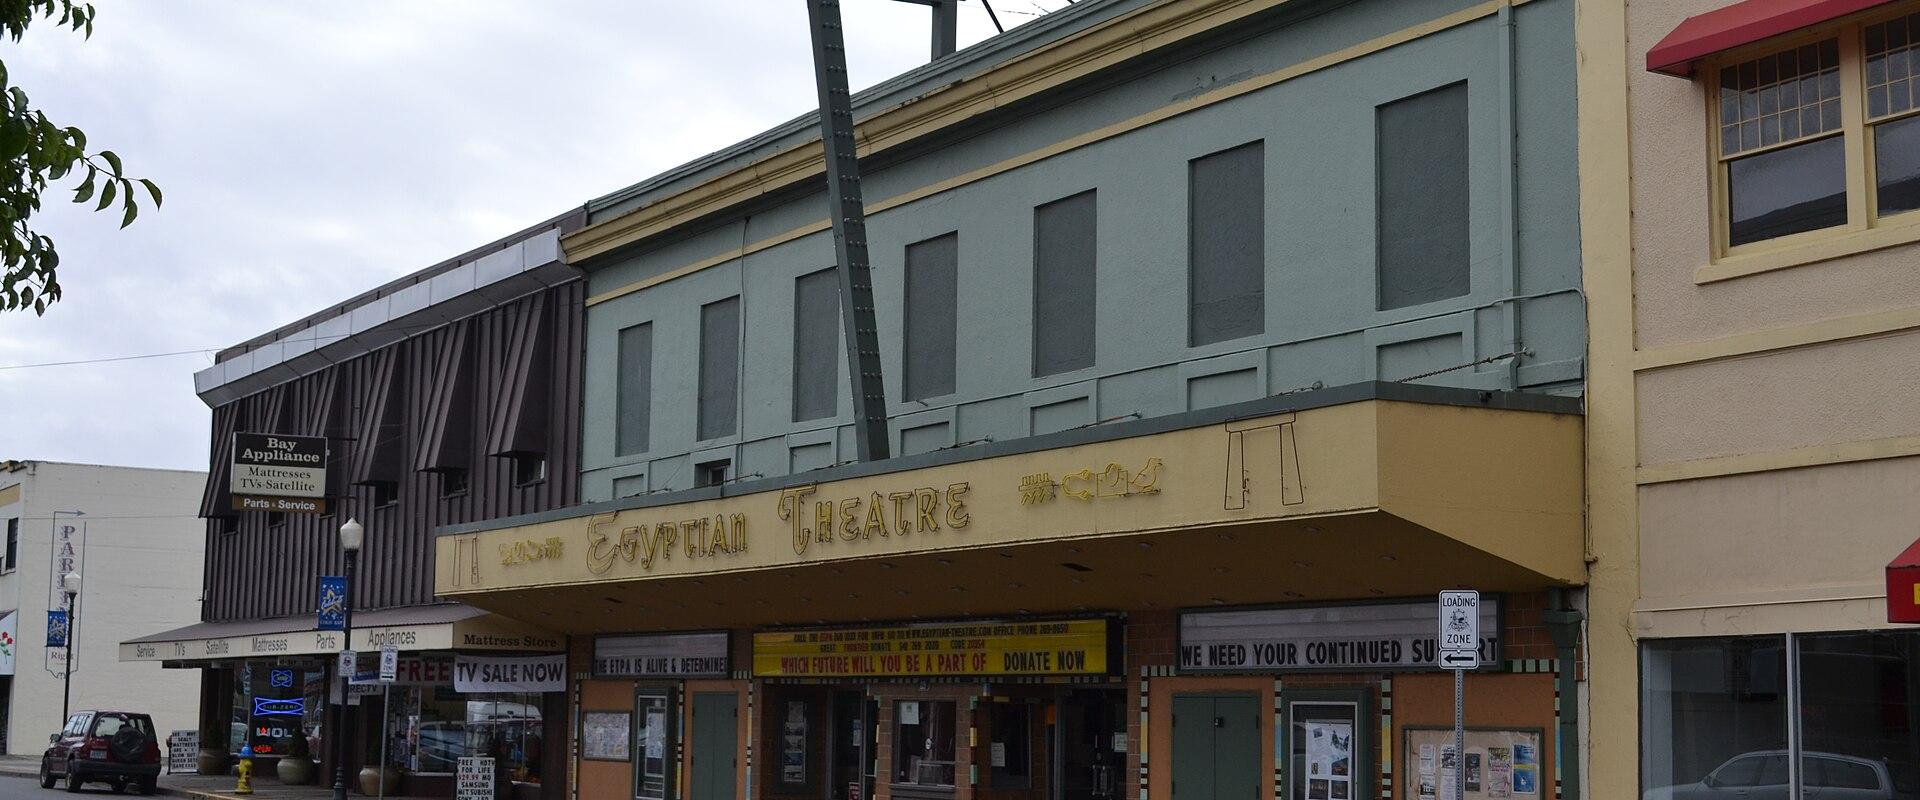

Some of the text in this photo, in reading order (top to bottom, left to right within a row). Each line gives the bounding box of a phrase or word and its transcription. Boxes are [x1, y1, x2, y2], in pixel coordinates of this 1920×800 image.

[266, 437, 297, 452] Bay
[241, 448, 320, 463] Appliance
[248, 466, 312, 480] Mattresses
[243, 498, 270, 508] Parts
[278, 500, 316, 510] Service
[776, 480, 971, 556] THEATRE
[1442, 597, 1476, 608] LOADING
[136, 645, 156, 659] Service
[205, 640, 230, 655] Satellite
[252, 637, 288, 653] Mattresses
[316, 633, 336, 650] Parts
[367, 629, 417, 650] Appliances
[463, 634, 558, 648] Mattress Store
[1446, 634, 1471, 644] ZONE
[51, 651, 74, 663] Rigt
[1181, 637, 1498, 667] WE NEED YOUR CONTINUED SURT
[594, 658, 607, 674] THE
[634, 658, 642, 673] IS
[646, 657, 668, 673] ALIVE
[671, 658, 677, 673] &
[781, 650, 1085, 674] WHICH FUTURE WILL YOU BE A PART OF DONATE NOW
[396, 659, 450, 682] FREE
[457, 662, 564, 684] TV SALE NOW
[349, 684, 377, 694] RECTV
